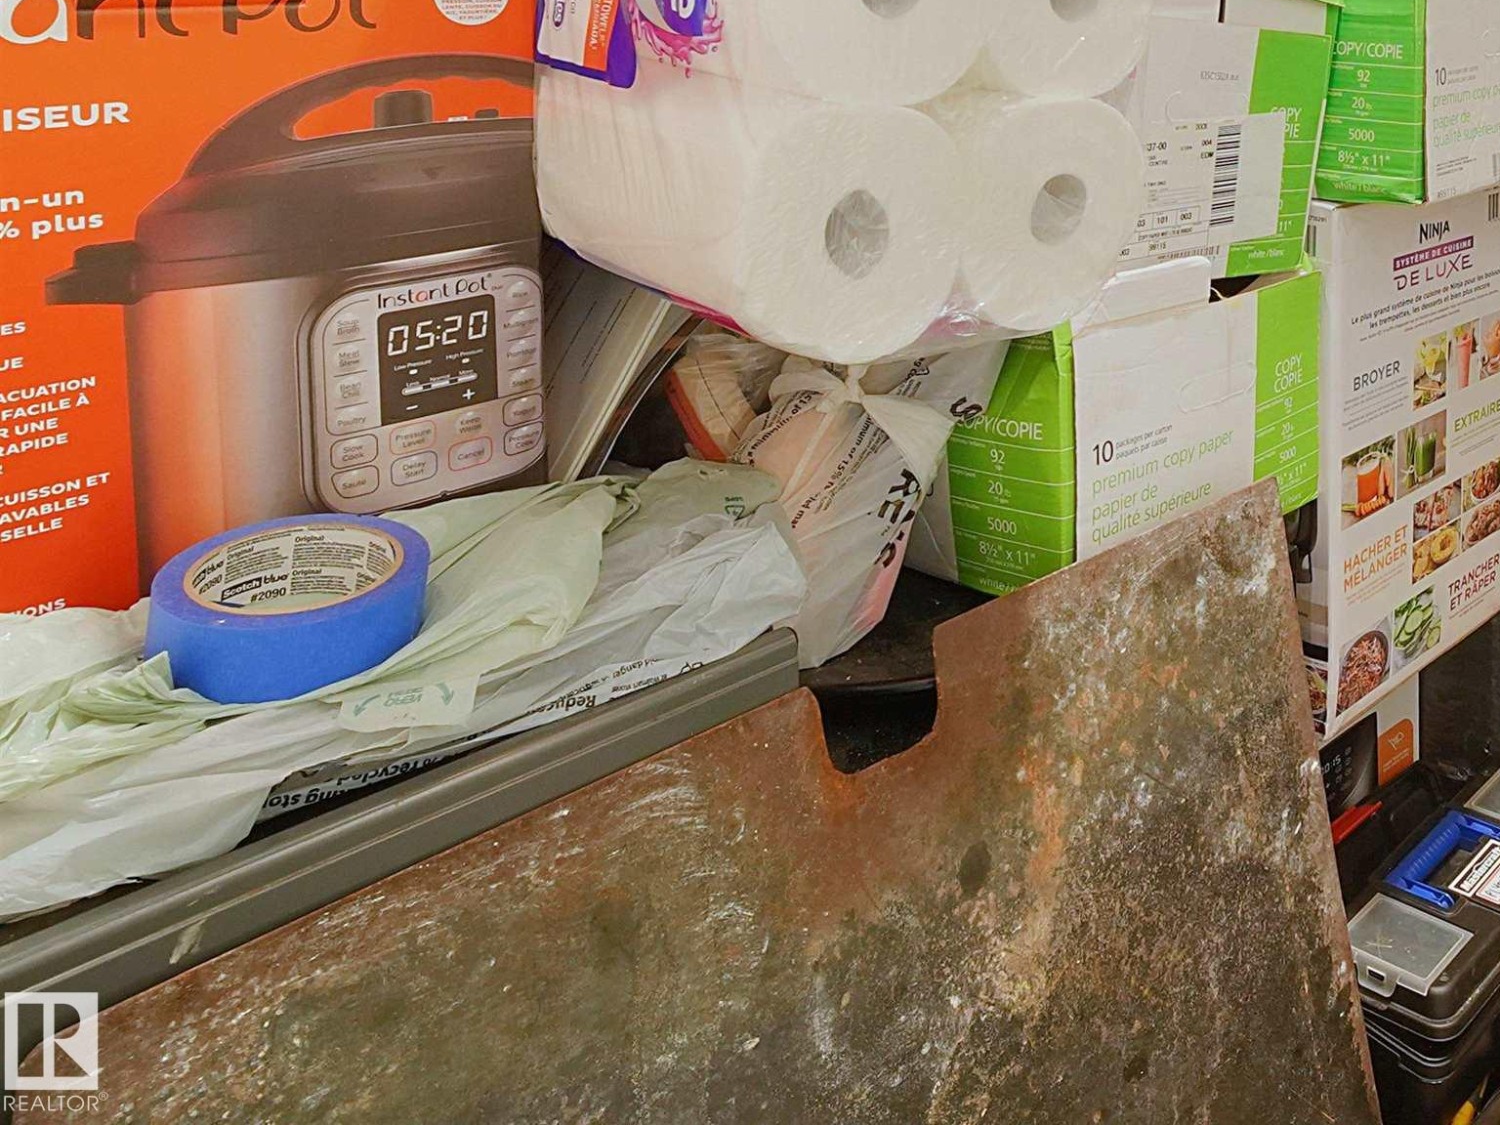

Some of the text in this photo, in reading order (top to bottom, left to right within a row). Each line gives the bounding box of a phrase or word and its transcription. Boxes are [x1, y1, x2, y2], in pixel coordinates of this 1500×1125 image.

[1356, 69, 1370, 83] 92
[1435, 67, 1447, 86] 10
[1351, 97, 1365, 110] 20
[1432, 86, 1492, 111] premium copy
[2, 101, 130, 131] ISEUR
[1348, 127, 1375, 142] 5000
[0, 189, 85, 213] n-un
[32, 213, 104, 239] plus
[1419, 220, 1450, 244] NINJA
[1395, 239, 1473, 268] SYSTÈME DE CUISINE
[377, 277, 487, 309] Instant Pot
[1359, 277, 1476, 323] plus grand système de cuisine de Ninja pour
[1421, 299, 1444, 312] desserts
[1450, 292, 1461, 302] bien
[1462, 288, 1473, 299] plus
[1473, 283, 1491, 293] encore
[1, 321, 26, 336] ES
[387, 310, 489, 357] 05:20
[1275, 355, 1302, 377] COPY
[1353, 360, 1400, 392] BROYER
[0, 376, 96, 403] ACUATION
[1273, 370, 1303, 393] COPIE
[1, 392, 90, 422] FACILE À
[14, 417, 59, 437] UNE
[337, 415, 367, 427] Poultry
[460, 416, 482, 426] Keep
[395, 429, 433, 442] Pressure
[402, 438, 427, 449] Level
[1092, 425, 1172, 465] 10 packages carton
[342, 452, 365, 462] Cook
[343, 445, 364, 455] Slow
[457, 448, 485, 461] Cancel
[989, 449, 1005, 464] 92
[1279, 446, 1297, 461] 5000
[402, 461, 427, 472] Delay
[1092, 430, 1233, 499] premium copy paper
[86, 472, 110, 488] ET
[988, 481, 1002, 495] 20
[0, 493, 90, 526] AVABLES
[1092, 483, 1158, 524] papier de
[1092, 482, 1211, 545] qualité supérieure
[0, 517, 63, 542] SELLE
[987, 517, 1017, 535] 5000
[294, 535, 325, 543] Original
[1343, 524, 1408, 573] HACHER ET
[227, 546, 254, 560] Original
[292, 568, 323, 577] Original
[1448, 553, 1500, 595] TRANCHER
[223, 573, 288, 598] Scotch blue
[251, 588, 287, 603] #2090
[1450, 594, 1463, 611] ET
